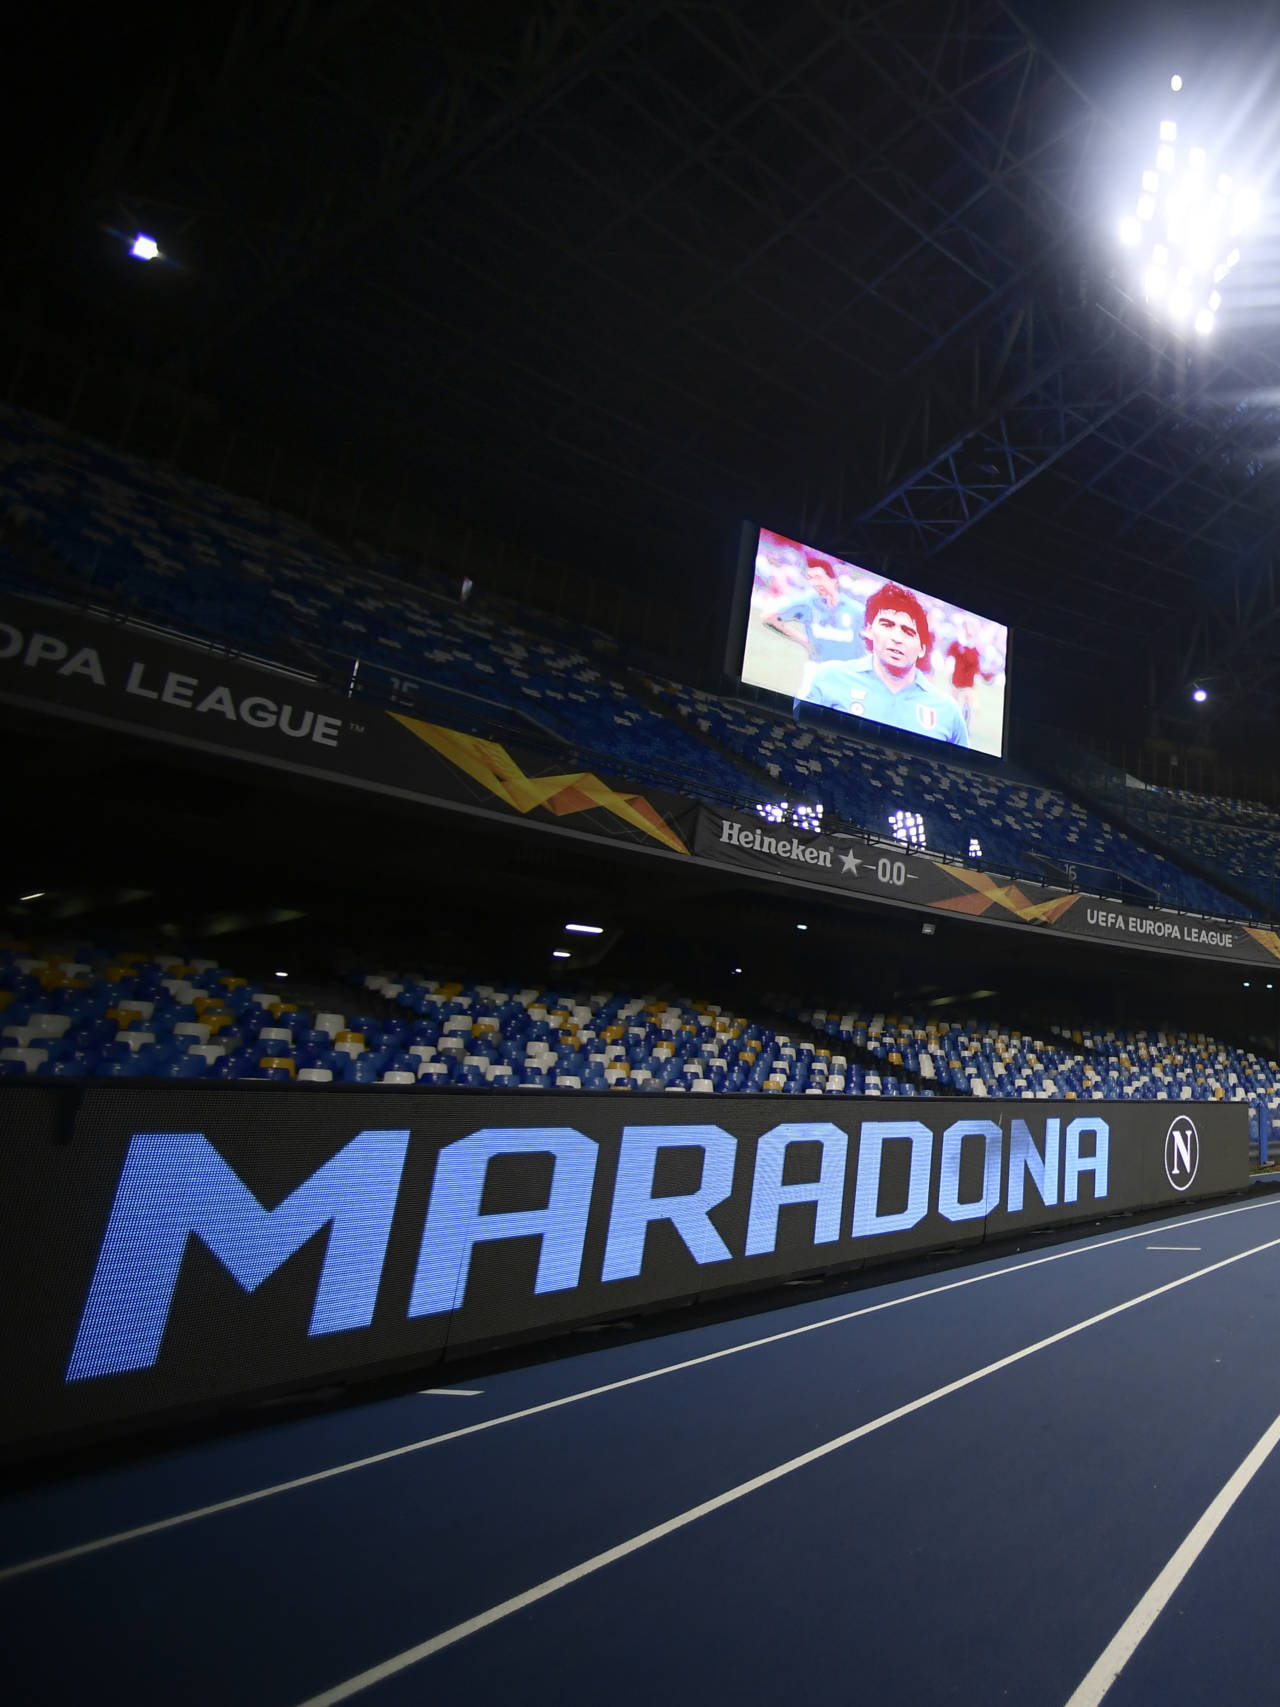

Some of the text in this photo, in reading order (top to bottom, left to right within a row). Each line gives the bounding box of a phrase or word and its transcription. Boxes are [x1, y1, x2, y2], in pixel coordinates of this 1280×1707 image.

[125, 661, 343, 748] LEAGUE
[720, 820, 832, 868] Heineken
[1087, 908, 1233, 948] UEFA EUROPA LEAGUE
[65, 1117, 1110, 1384] MARADONA
